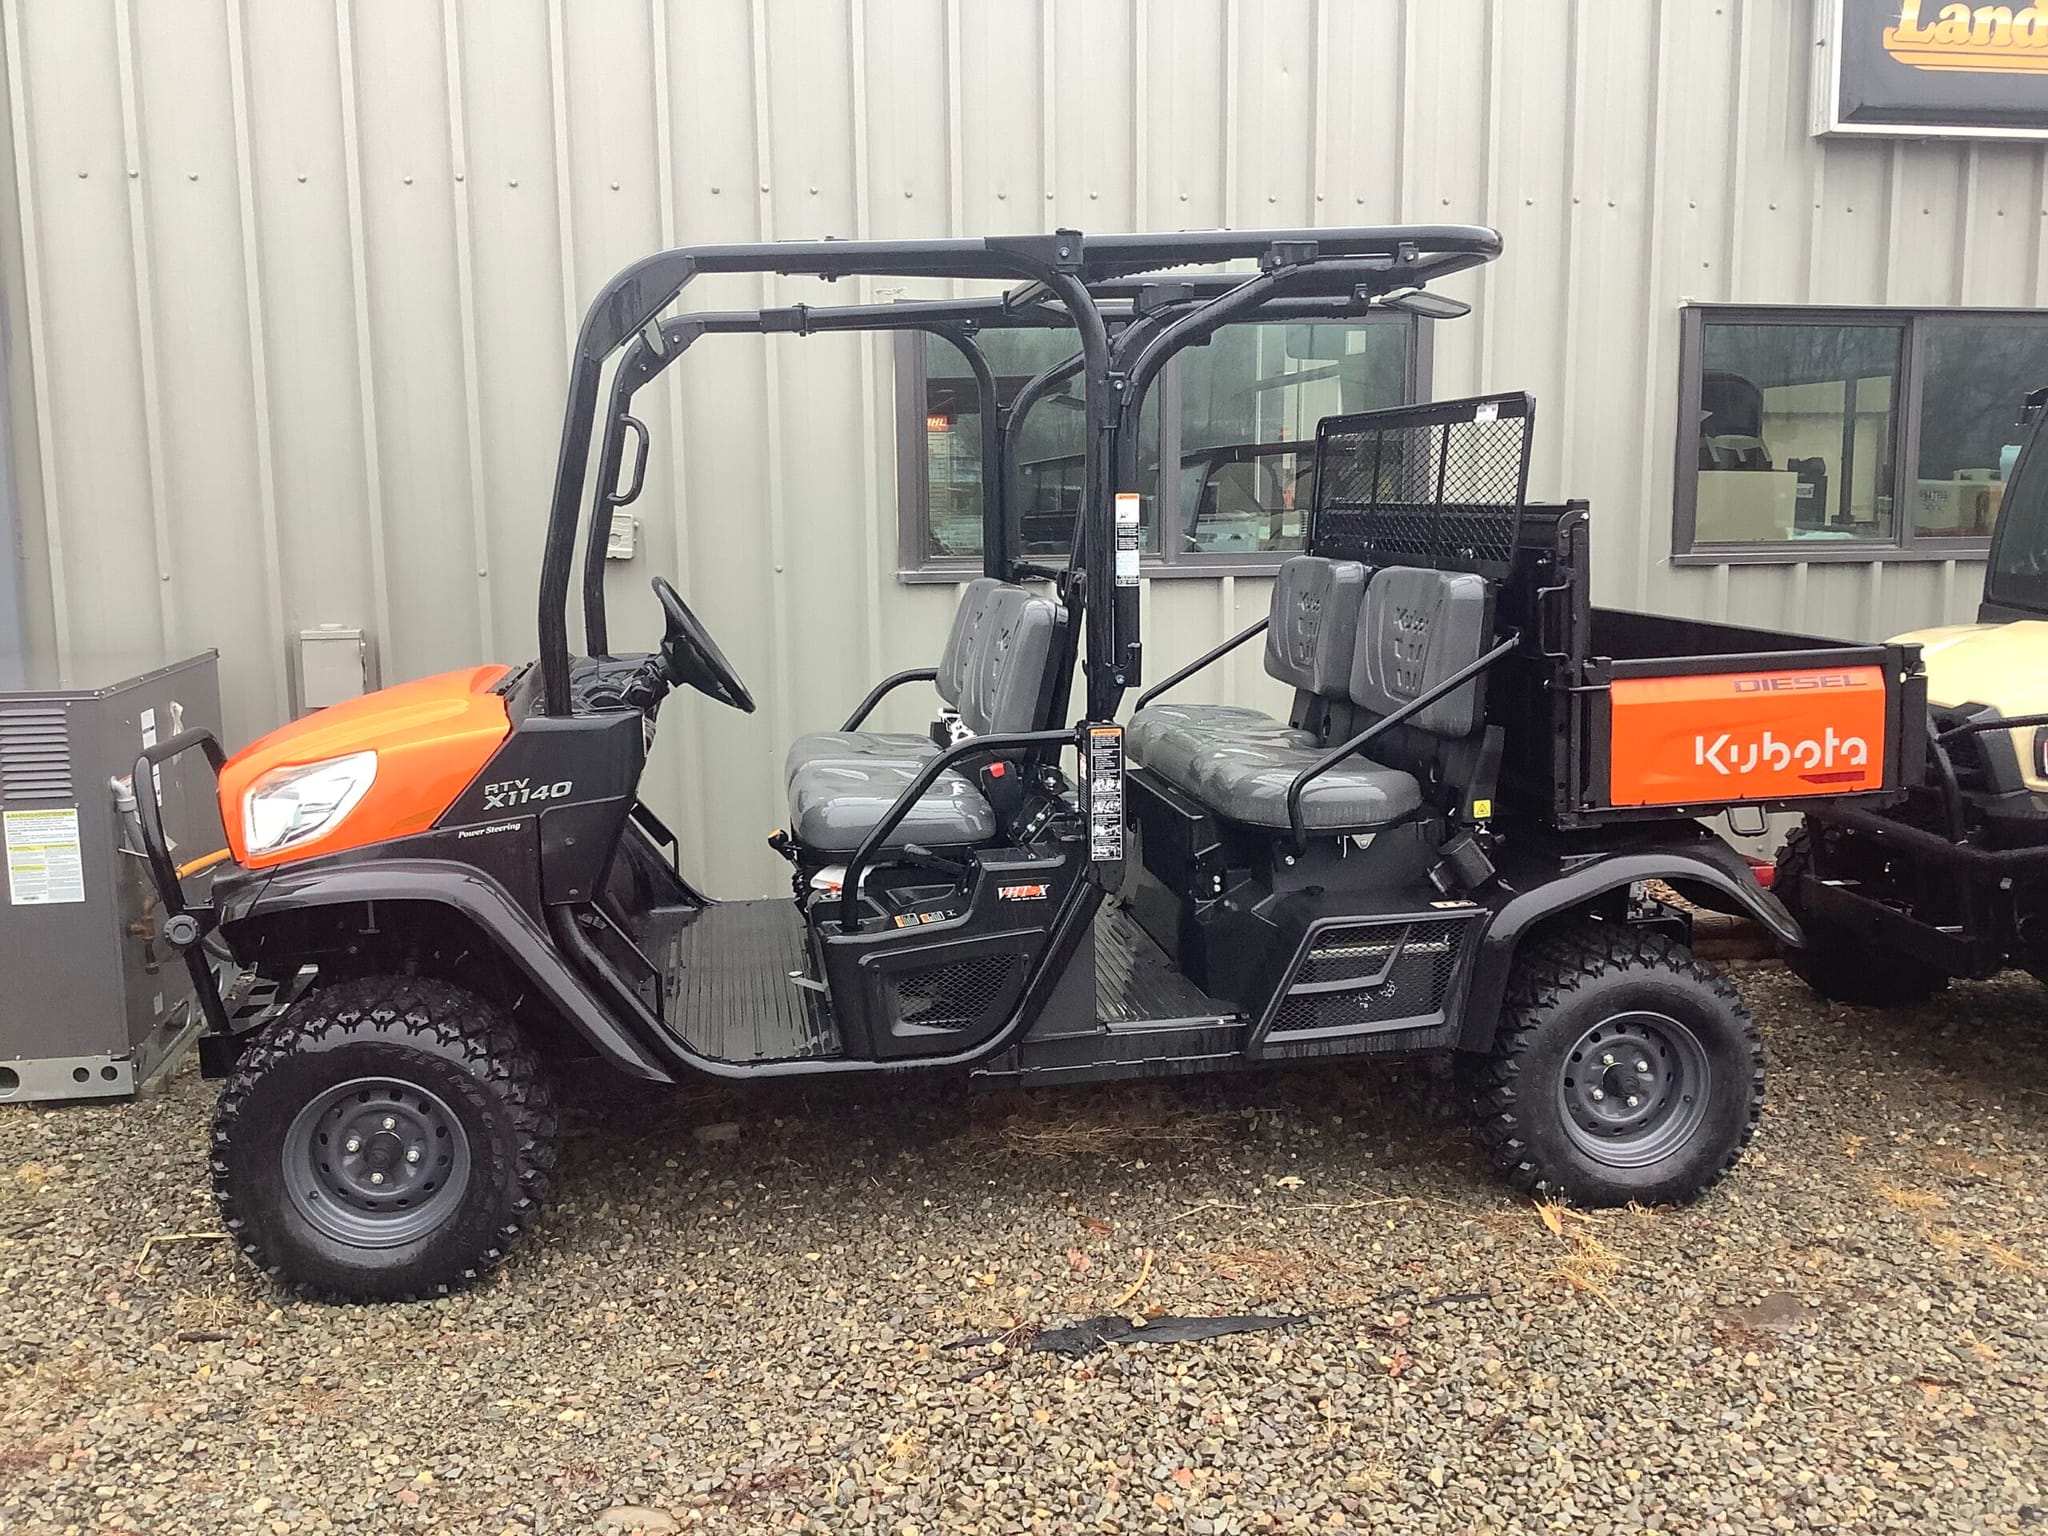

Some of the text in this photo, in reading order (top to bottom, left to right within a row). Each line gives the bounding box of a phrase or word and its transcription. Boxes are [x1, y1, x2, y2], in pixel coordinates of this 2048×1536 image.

[1735, 675, 1867, 692] DIESEL
[1695, 727, 1867, 774] Kubota
[483, 781, 573, 811] X1140
[484, 777, 530, 796] RTV
[458, 822, 521, 840] Power Steering
